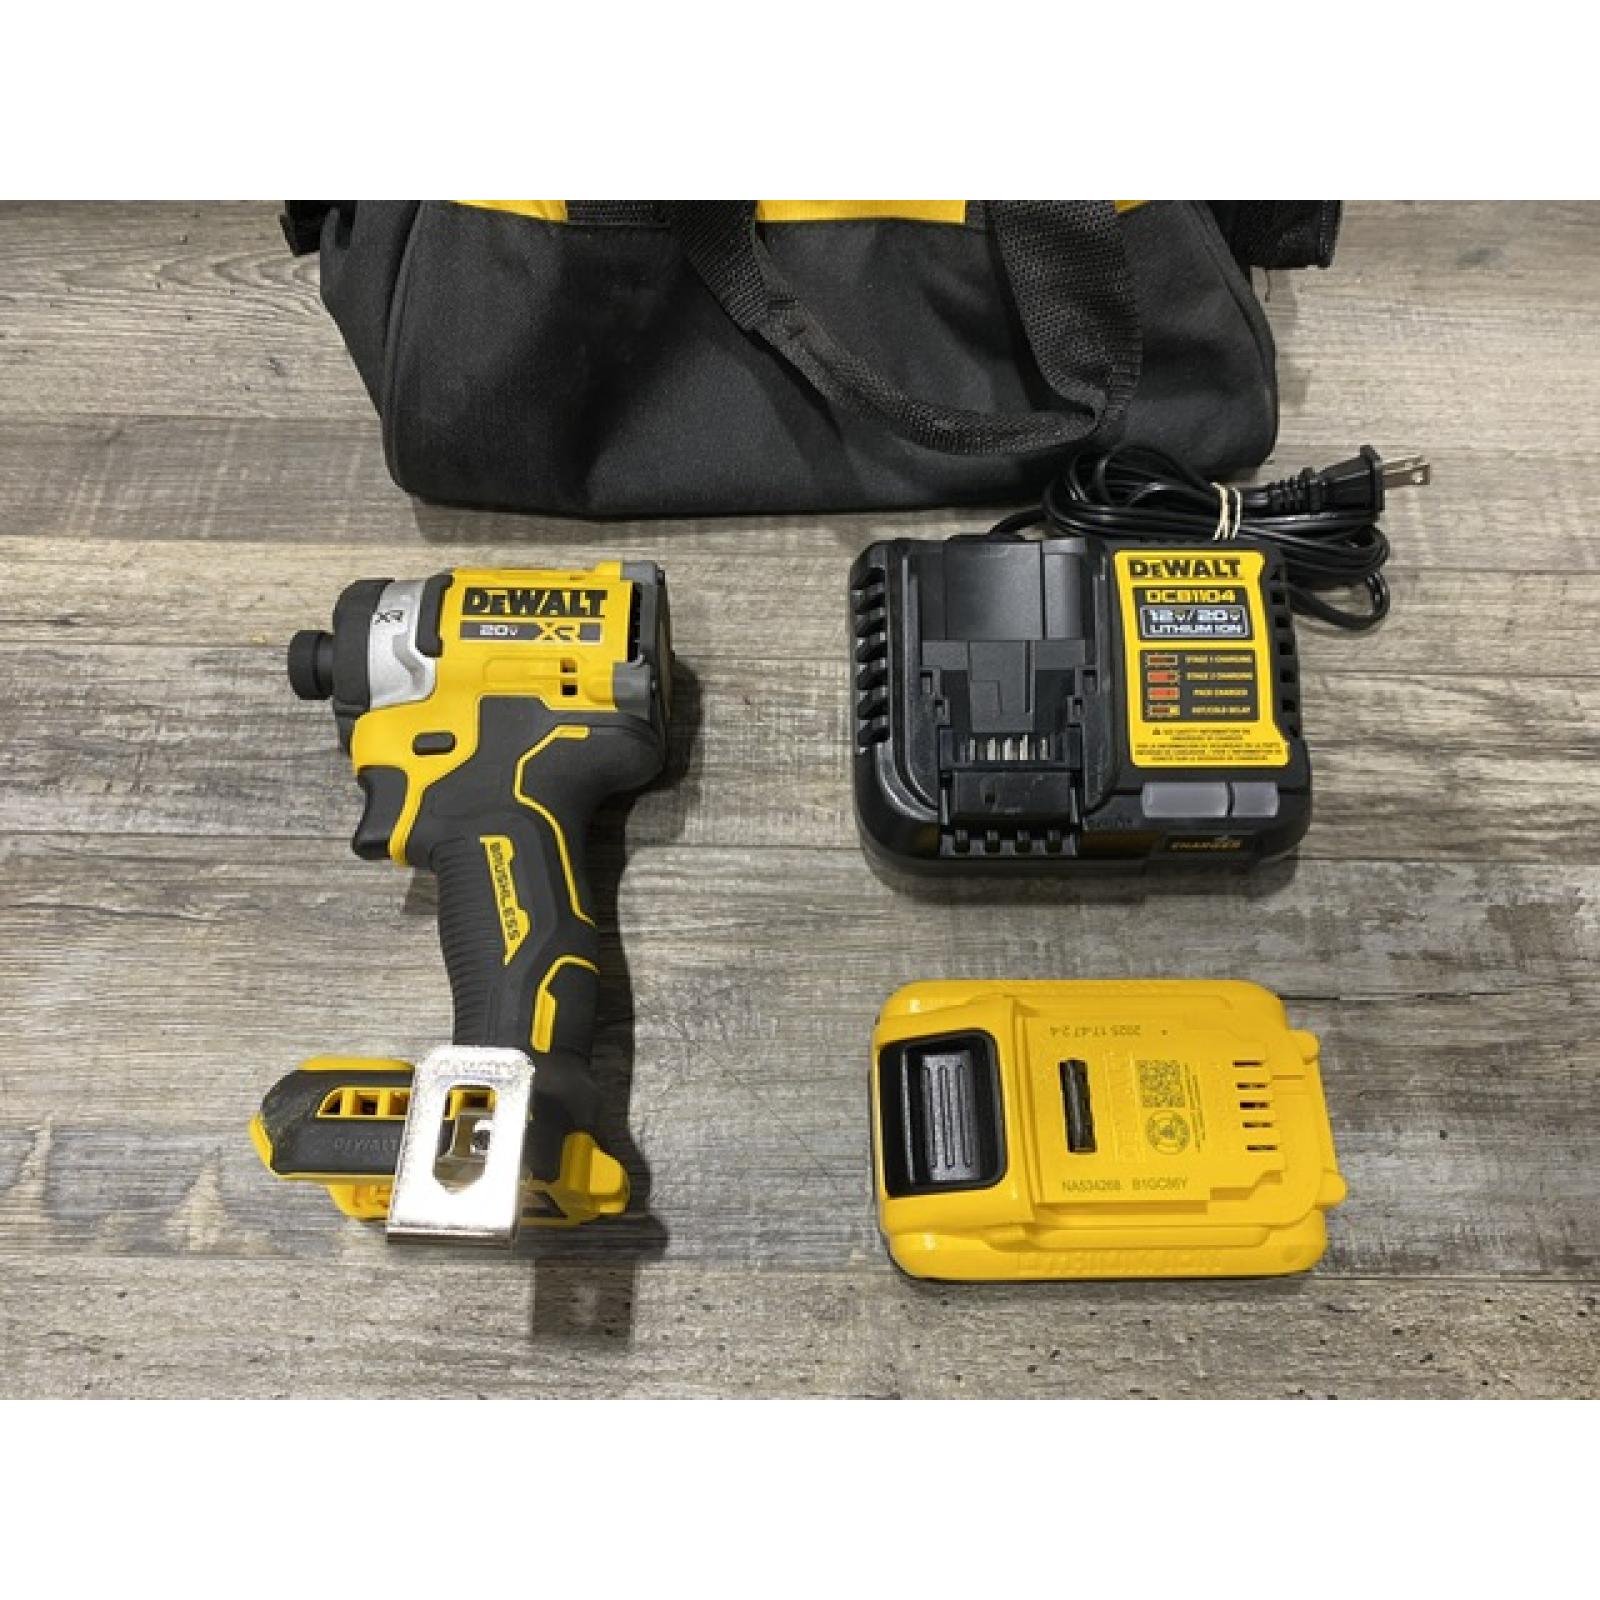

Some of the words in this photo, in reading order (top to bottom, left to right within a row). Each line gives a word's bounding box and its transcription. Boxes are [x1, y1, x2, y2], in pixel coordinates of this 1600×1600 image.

[1129, 559, 1240, 577] DEWALT
[462, 587, 608, 616] DEWALT
[1145, 589, 1235, 603] DCB1104
[1150, 624, 1213, 634] LITHIUM
[1215, 624, 1242, 634] ION
